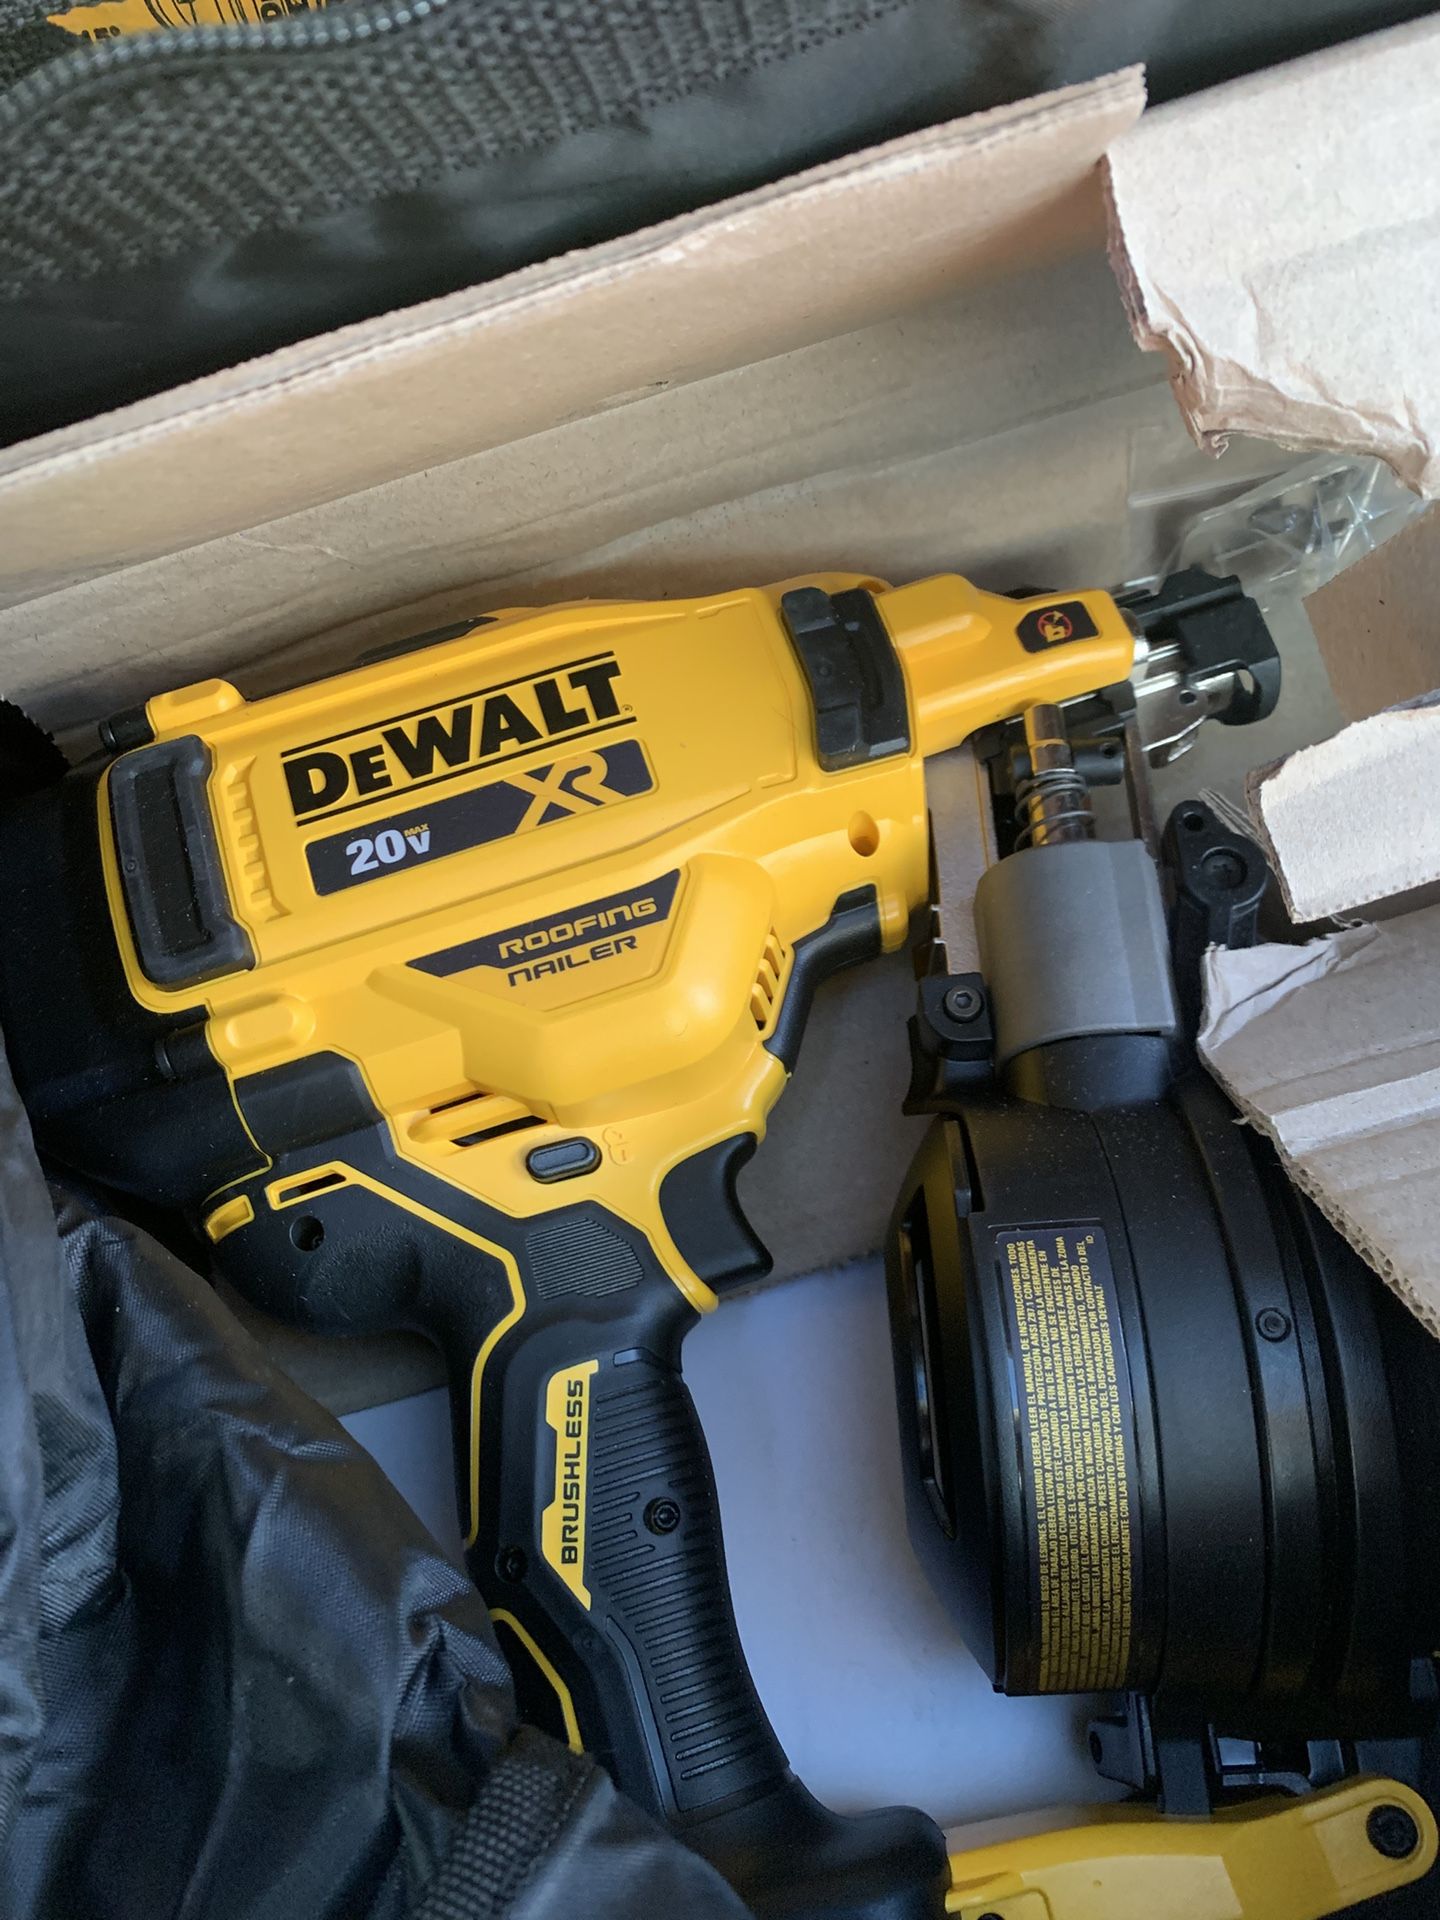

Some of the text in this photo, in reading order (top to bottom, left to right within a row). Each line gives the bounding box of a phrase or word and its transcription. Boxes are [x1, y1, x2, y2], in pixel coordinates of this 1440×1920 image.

[283, 661, 621, 815] DEWALT
[502, 751, 628, 833] XR
[404, 823, 429, 837] MAX
[499, 897, 657, 959] ROOFING
[508, 935, 637, 987] NAILER
[1006, 1243, 1017, 1264] TODO
[1016, 1241, 1030, 1279] GUARDAS
[1038, 1250, 1047, 1262] EN
[1055, 1236, 1067, 1258] ZONA
[1076, 1241, 1086, 1255] DEL
[1026, 1240, 1043, 1296] HERRAMIENTA
[1051, 1267, 1060, 1277] DE
[1059, 1260, 1069, 1270] LA
[1062, 1272, 1071, 1283] EN
[1023, 1281, 1033, 1299] CON
[1040, 1263, 1055, 1312] ENCUENTRE
[1053, 1279, 1065, 1307] ANTES
[1070, 1265, 1084, 1300] CUANDO
[1080, 1265, 1095, 1309] CONTACTO
[1035, 1298, 1044, 1308] LA
[1064, 1285, 1078, 1331] PERSONAS
[1037, 1310, 1051, 1354] ACCIONAR
[1048, 1314, 1057, 1325] SE
[1088, 1311, 1098, 1329] POR
[1020, 1338, 1029, 1349] DE
[1029, 1324, 1039, 1346] ANSI
[1050, 1328, 1059, 1340] NO
[1057, 1310, 1074, 1373] DEBIDAMENTE
[1077, 1302, 1095, 1382] MANTENIMIENTO,
[1043, 1357, 1052, 1369] NO
[1091, 1330, 1106, 1389] DISPARADOR
[1100, 1322, 1116, 1383] CARGADORES
[1022, 1352, 1034, 1392] MANUAL
[1045, 1372, 1054, 1383] DE
[1052, 1343, 1067, 1408] HERRAMIENTA
[1076, 1368, 1085, 1385] LAS
[1027, 1394, 1036, 1404] EL
[1047, 1386, 1056, 1399] FIN
[1066, 1376, 1080, 1429] FUNCIONEN
[1078, 1388, 1089, 1416] HACIA
[1088, 1384, 1097, 1396] DE
[1099, 1391, 1109, 1408] DEL
[1109, 1385, 1119, 1402] LOS
[1028, 1407, 1038, 1428] LEER
[1039, 1408, 1048, 1419] DE
[1060, 1410, 1069, 1421] LA
[1090, 1399, 1100, 1419] TIPO
[1111, 1404, 1121, 1424] CON
[1049, 1411, 1062, 1458] CLAVANDO
[1081, 1418, 1090, 1429] NI
[1101, 1410, 1114, 1463] APROPIADO
[1040, 1422, 1052, 1470] ANTEOJOS
[1061, 1424, 1073, 1462] CUANDO
[1072, 1431, 1084, 1479] CONTACTO
[1083, 1431, 1093, 1464] MISMO
[1092, 1421, 1104, 1472] CUALQUIER
[561, 1380, 584, 1564] BRUSHLESS
[1065, 1465, 1075, 1500] SEGURO
[1034, 1469, 1045, 1508] USUARIO
[1045, 1472, 1055, 1503] LLEVAR
[1056, 1483, 1065, 1496] NO
[1077, 1481, 1086, 1499] POR
[1087, 1477, 1096, 1504] HACIA
[1097, 1474, 1107, 1506] PRESTE
[1118, 1481, 1127, 1497] LAS
[1037, 1510, 1045, 1518] EL
[1057, 1498, 1067, 1533] CUANDO
[1068, 1502, 1076, 1512] EL
[1107, 1465, 1119, 1543] FUNCIONAMIENTO
[1120, 1499, 1129, 1517] CON
[1069, 1514, 1078, 1545] UTILICE
[1078, 1501, 1089, 1554] DISPARADOR
[1112, 1545, 1120, 1554] EL
